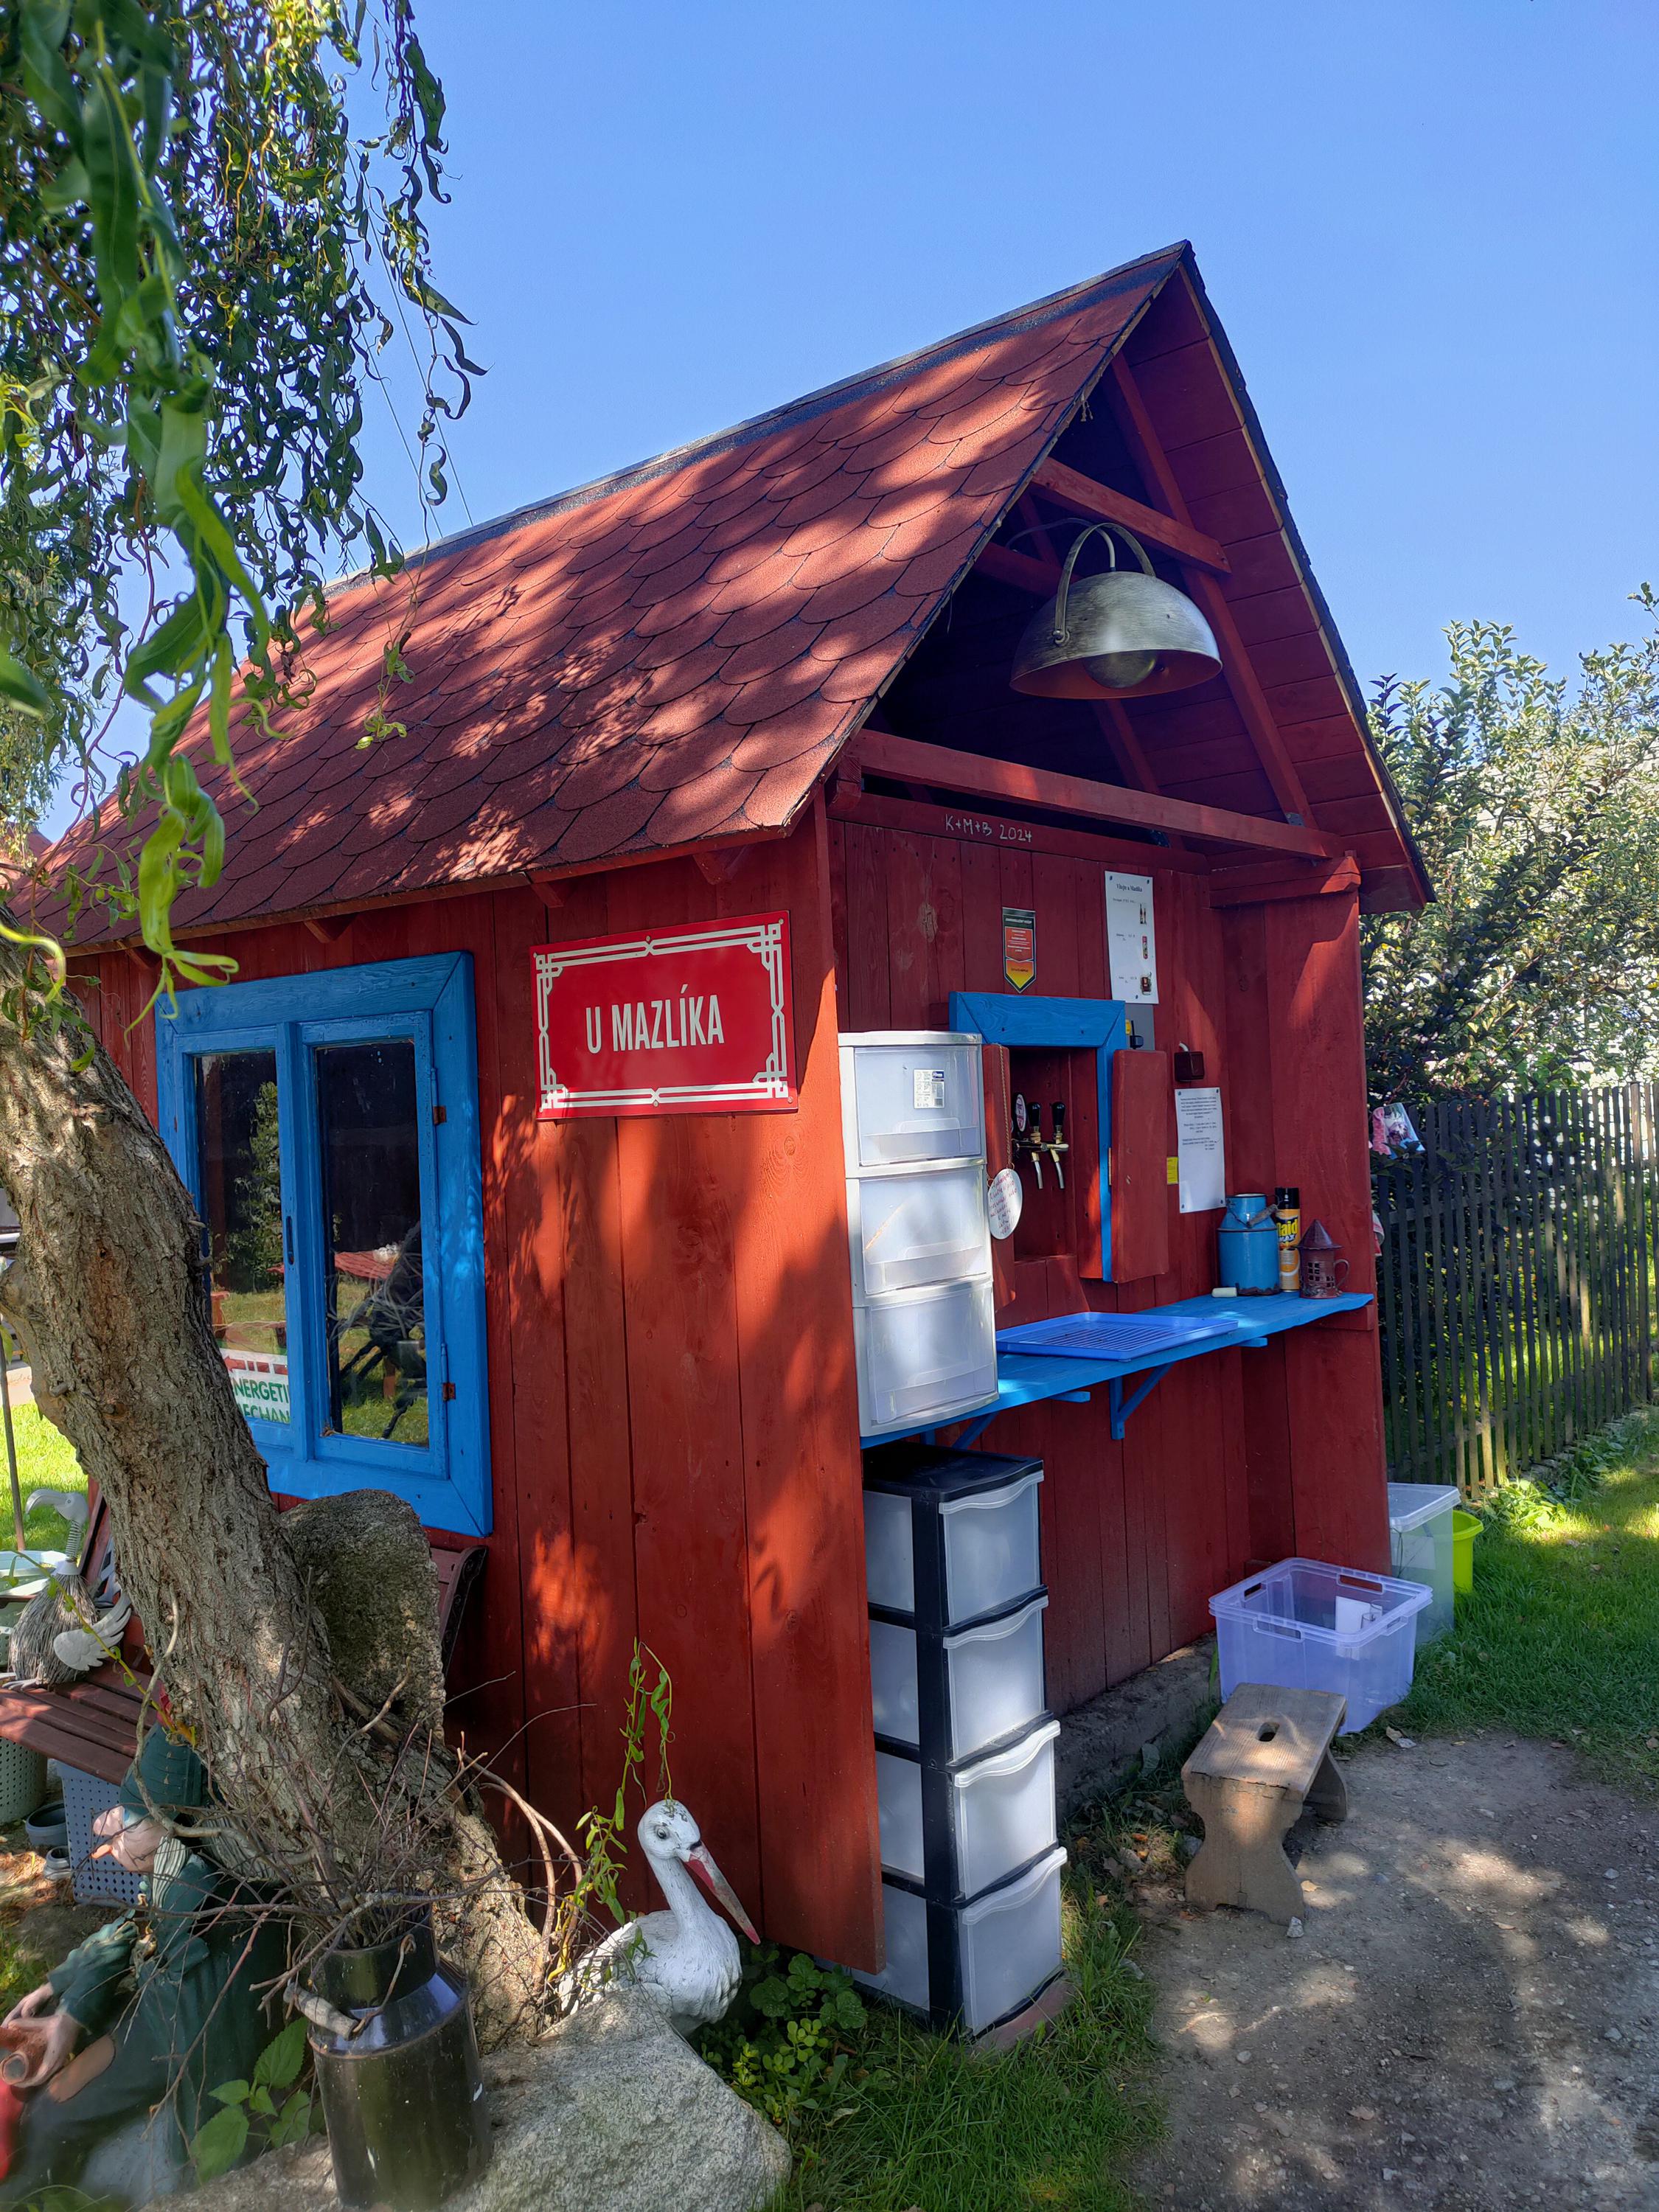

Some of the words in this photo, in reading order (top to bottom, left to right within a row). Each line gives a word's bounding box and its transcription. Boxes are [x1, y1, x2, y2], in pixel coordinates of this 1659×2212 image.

[999, 824, 1032, 843] 2024
[585, 1006, 602, 1054] U
[611, 984, 725, 1052] MAZLÍKA
[232, 1377, 290, 1404] NERGETI
[237, 1403, 291, 1423] ECHAN
